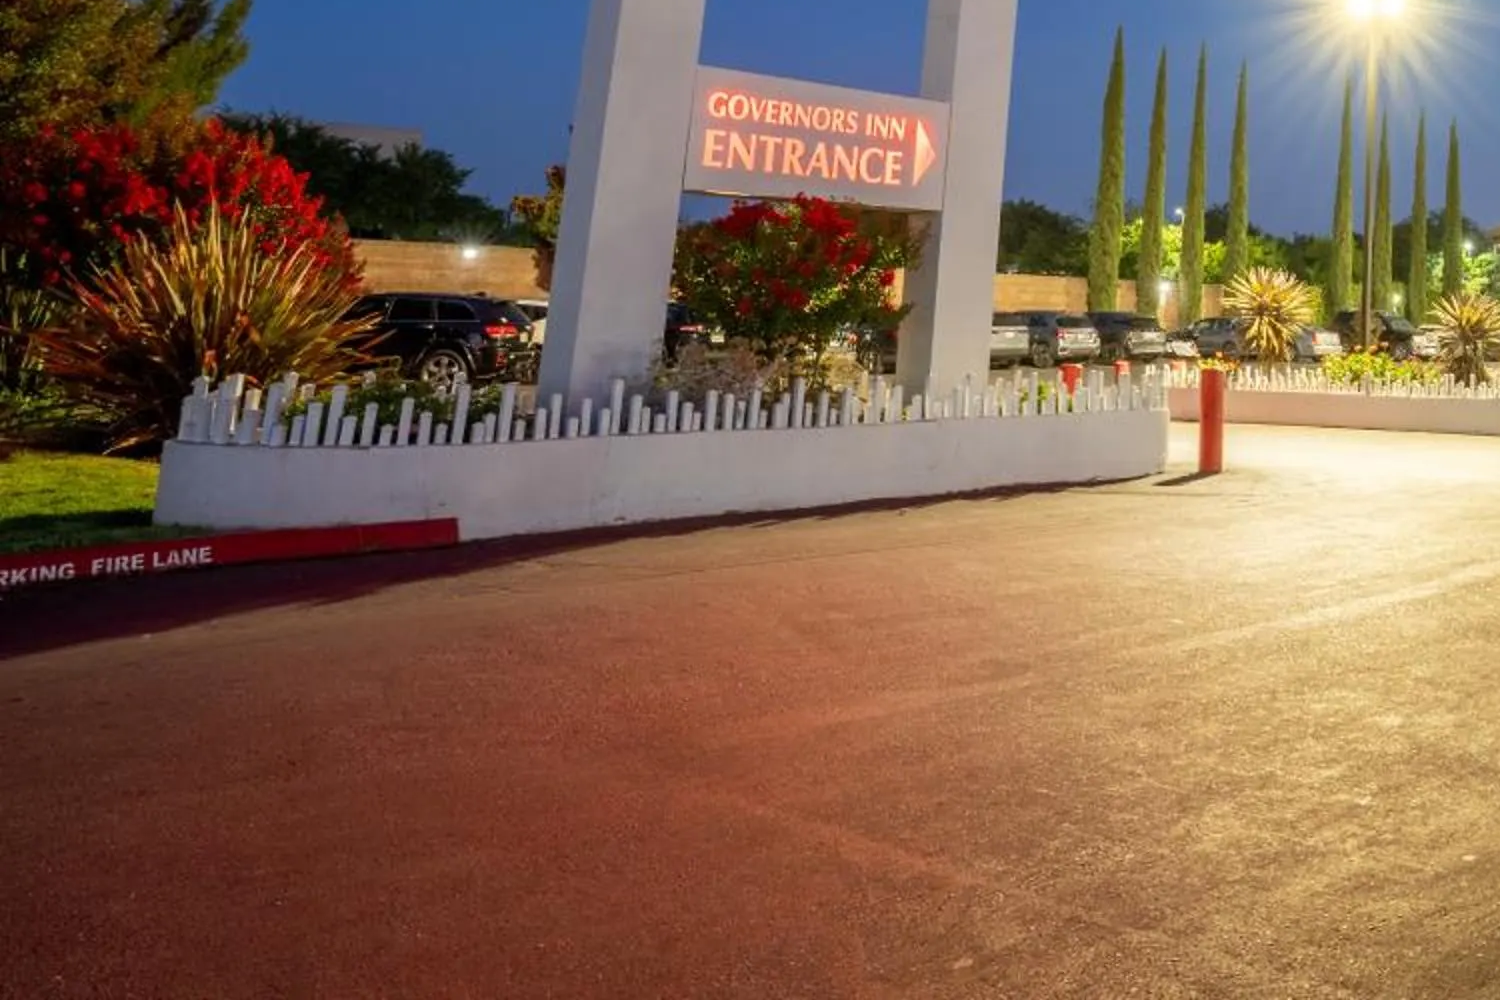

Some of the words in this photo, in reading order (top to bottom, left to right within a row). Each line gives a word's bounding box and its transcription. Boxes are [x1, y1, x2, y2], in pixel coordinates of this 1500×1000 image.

[707, 91, 859, 134] GOVERNORS
[865, 112, 907, 141] INN
[702, 128, 903, 186] ENTRANCE
[91, 553, 145, 576] FIRE
[153, 546, 213, 569] LANE
